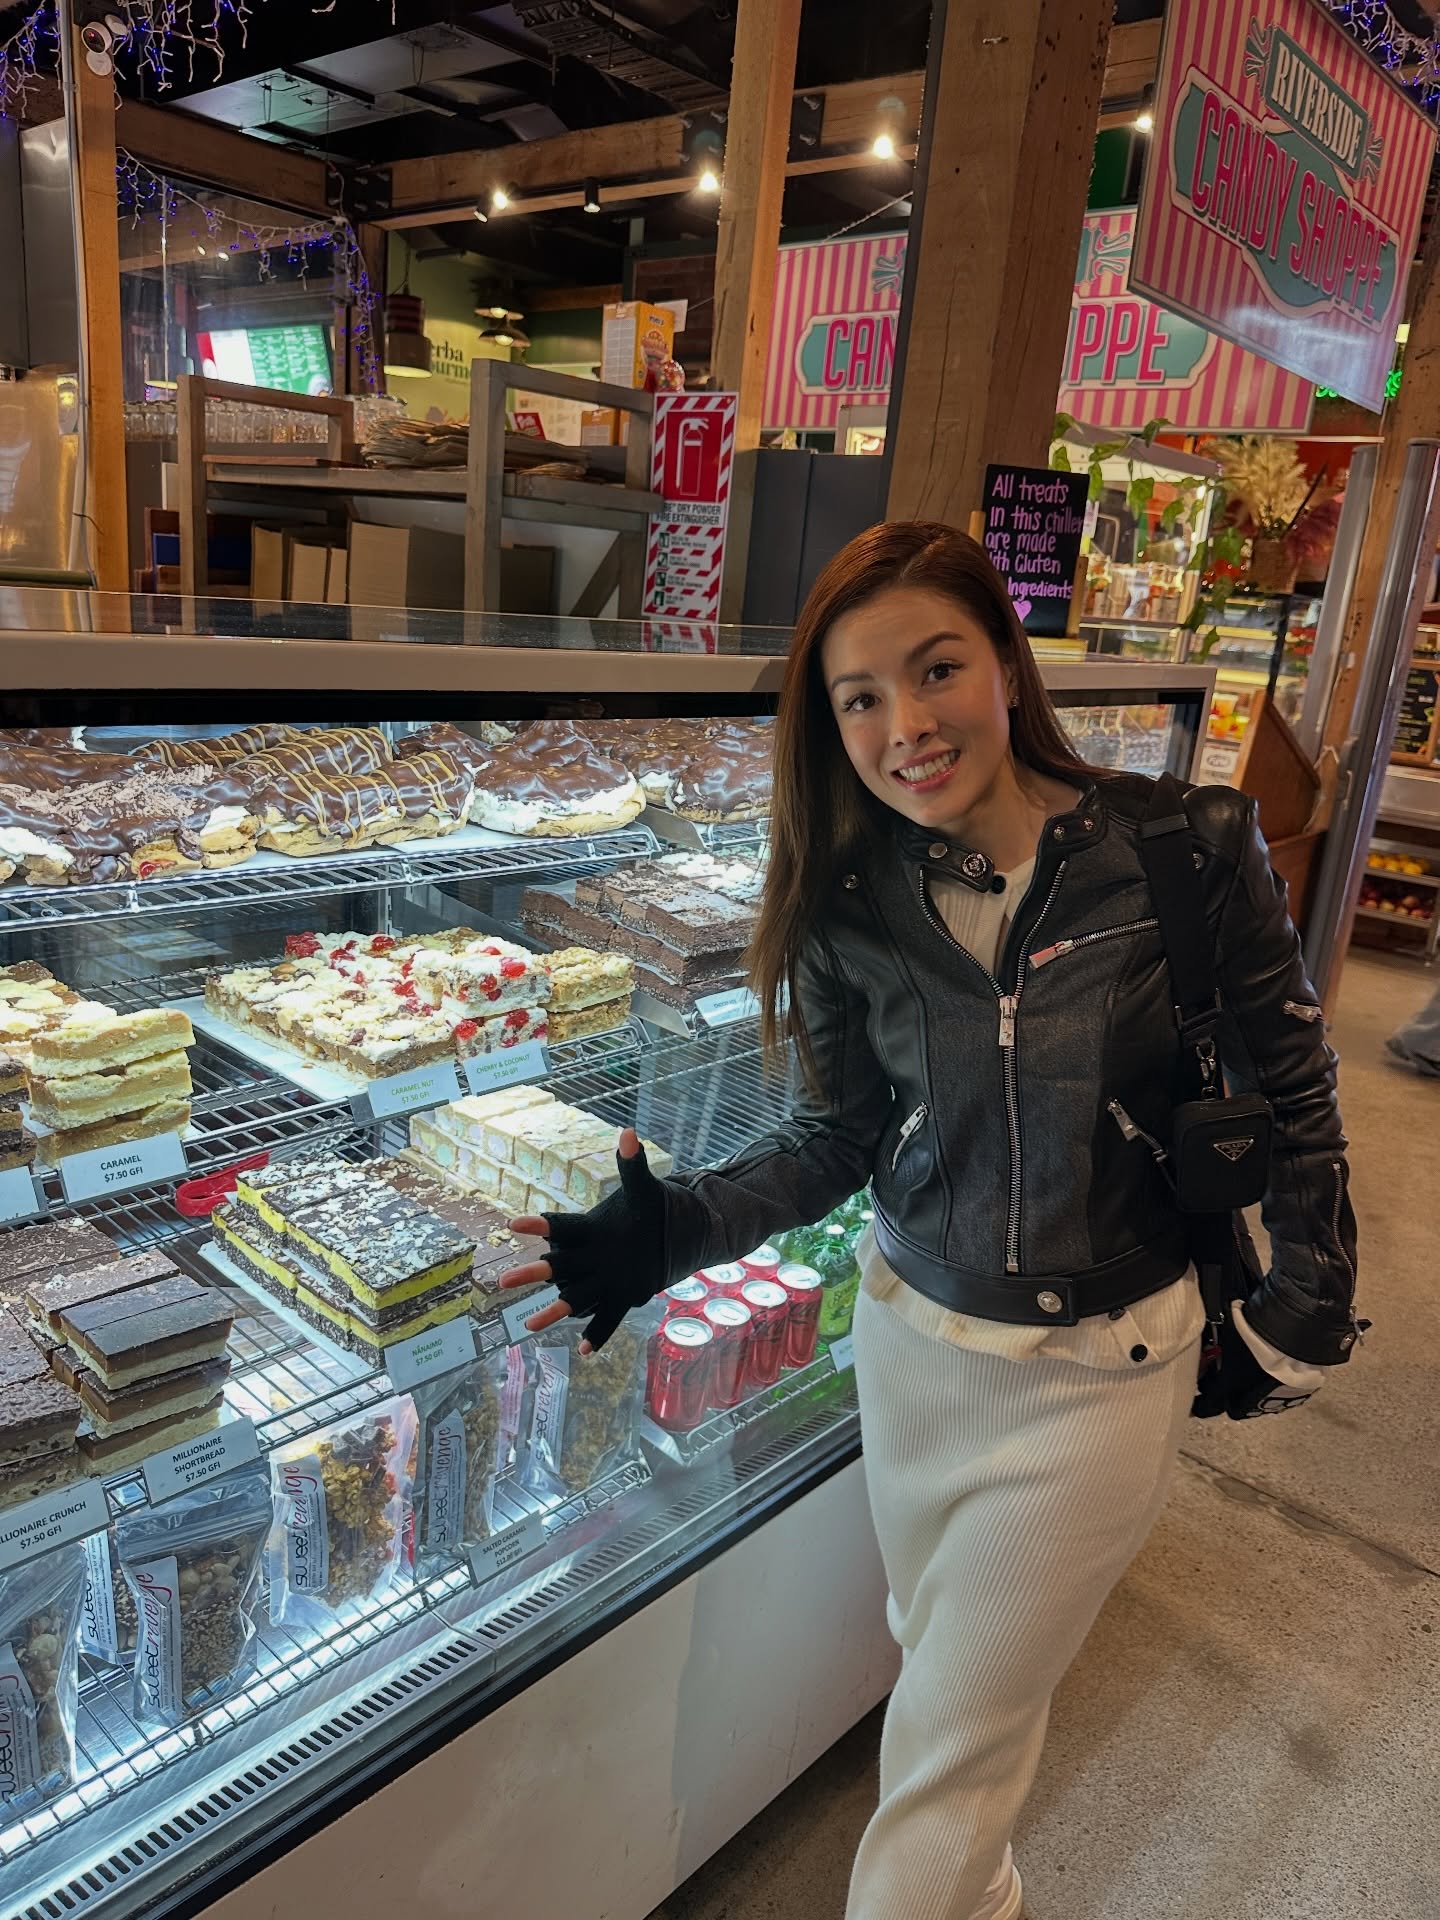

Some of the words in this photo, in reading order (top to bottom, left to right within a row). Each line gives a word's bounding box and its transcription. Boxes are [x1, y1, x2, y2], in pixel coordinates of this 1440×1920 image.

[1271, 41, 1362, 169] RIVERSIDE
[1190, 90, 1298, 261] CANDY
[1289, 169, 1388, 319] SHOPPE
[823, 315, 897, 390] CAN
[1067, 301, 1169, 384] PPE
[992, 473, 1015, 500] All
[1018, 475, 1069, 504] treats
[671, 513, 720, 525] EXTINGUISHER
[677, 504, 691, 514] DRY
[692, 504, 721, 516] POWDER
[1010, 505, 1042, 532] this
[985, 532, 1011, 550] are
[1016, 531, 1057, 553] made
[989, 551, 1010, 572] ith
[1014, 553, 1062, 575] Gluten
[476, 1063, 498, 1075] CHERRY
[504, 1053, 531, 1067] COCONUT
[391, 1083, 422, 1096] CARAMEL
[421, 1079, 435, 1090] NUT
[100, 1154, 142, 1171] CARAMEL
[104, 1170, 128, 1183] $7.50
[129, 1166, 143, 1177] GFI
[515, 1308, 536, 1322] COFFEE
[415, 1353, 433, 1367] $7.50
[432, 1349, 444, 1361] GFI
[172, 1435, 223, 1463] MILLIONAIRE
[174, 1446, 226, 1475] SHORTBREAD
[185, 1467, 208, 1484] $7.50
[208, 1461, 221, 1475] GFI
[0, 1516, 48, 1545] LLIONAIRE
[49, 1500, 87, 1523] CRUNCH
[20, 1532, 45, 1550] $7.50
[46, 1525, 62, 1539] GFI
[482, 1539, 503, 1555] SALTED
[494, 1538, 520, 1558] POPCORN
